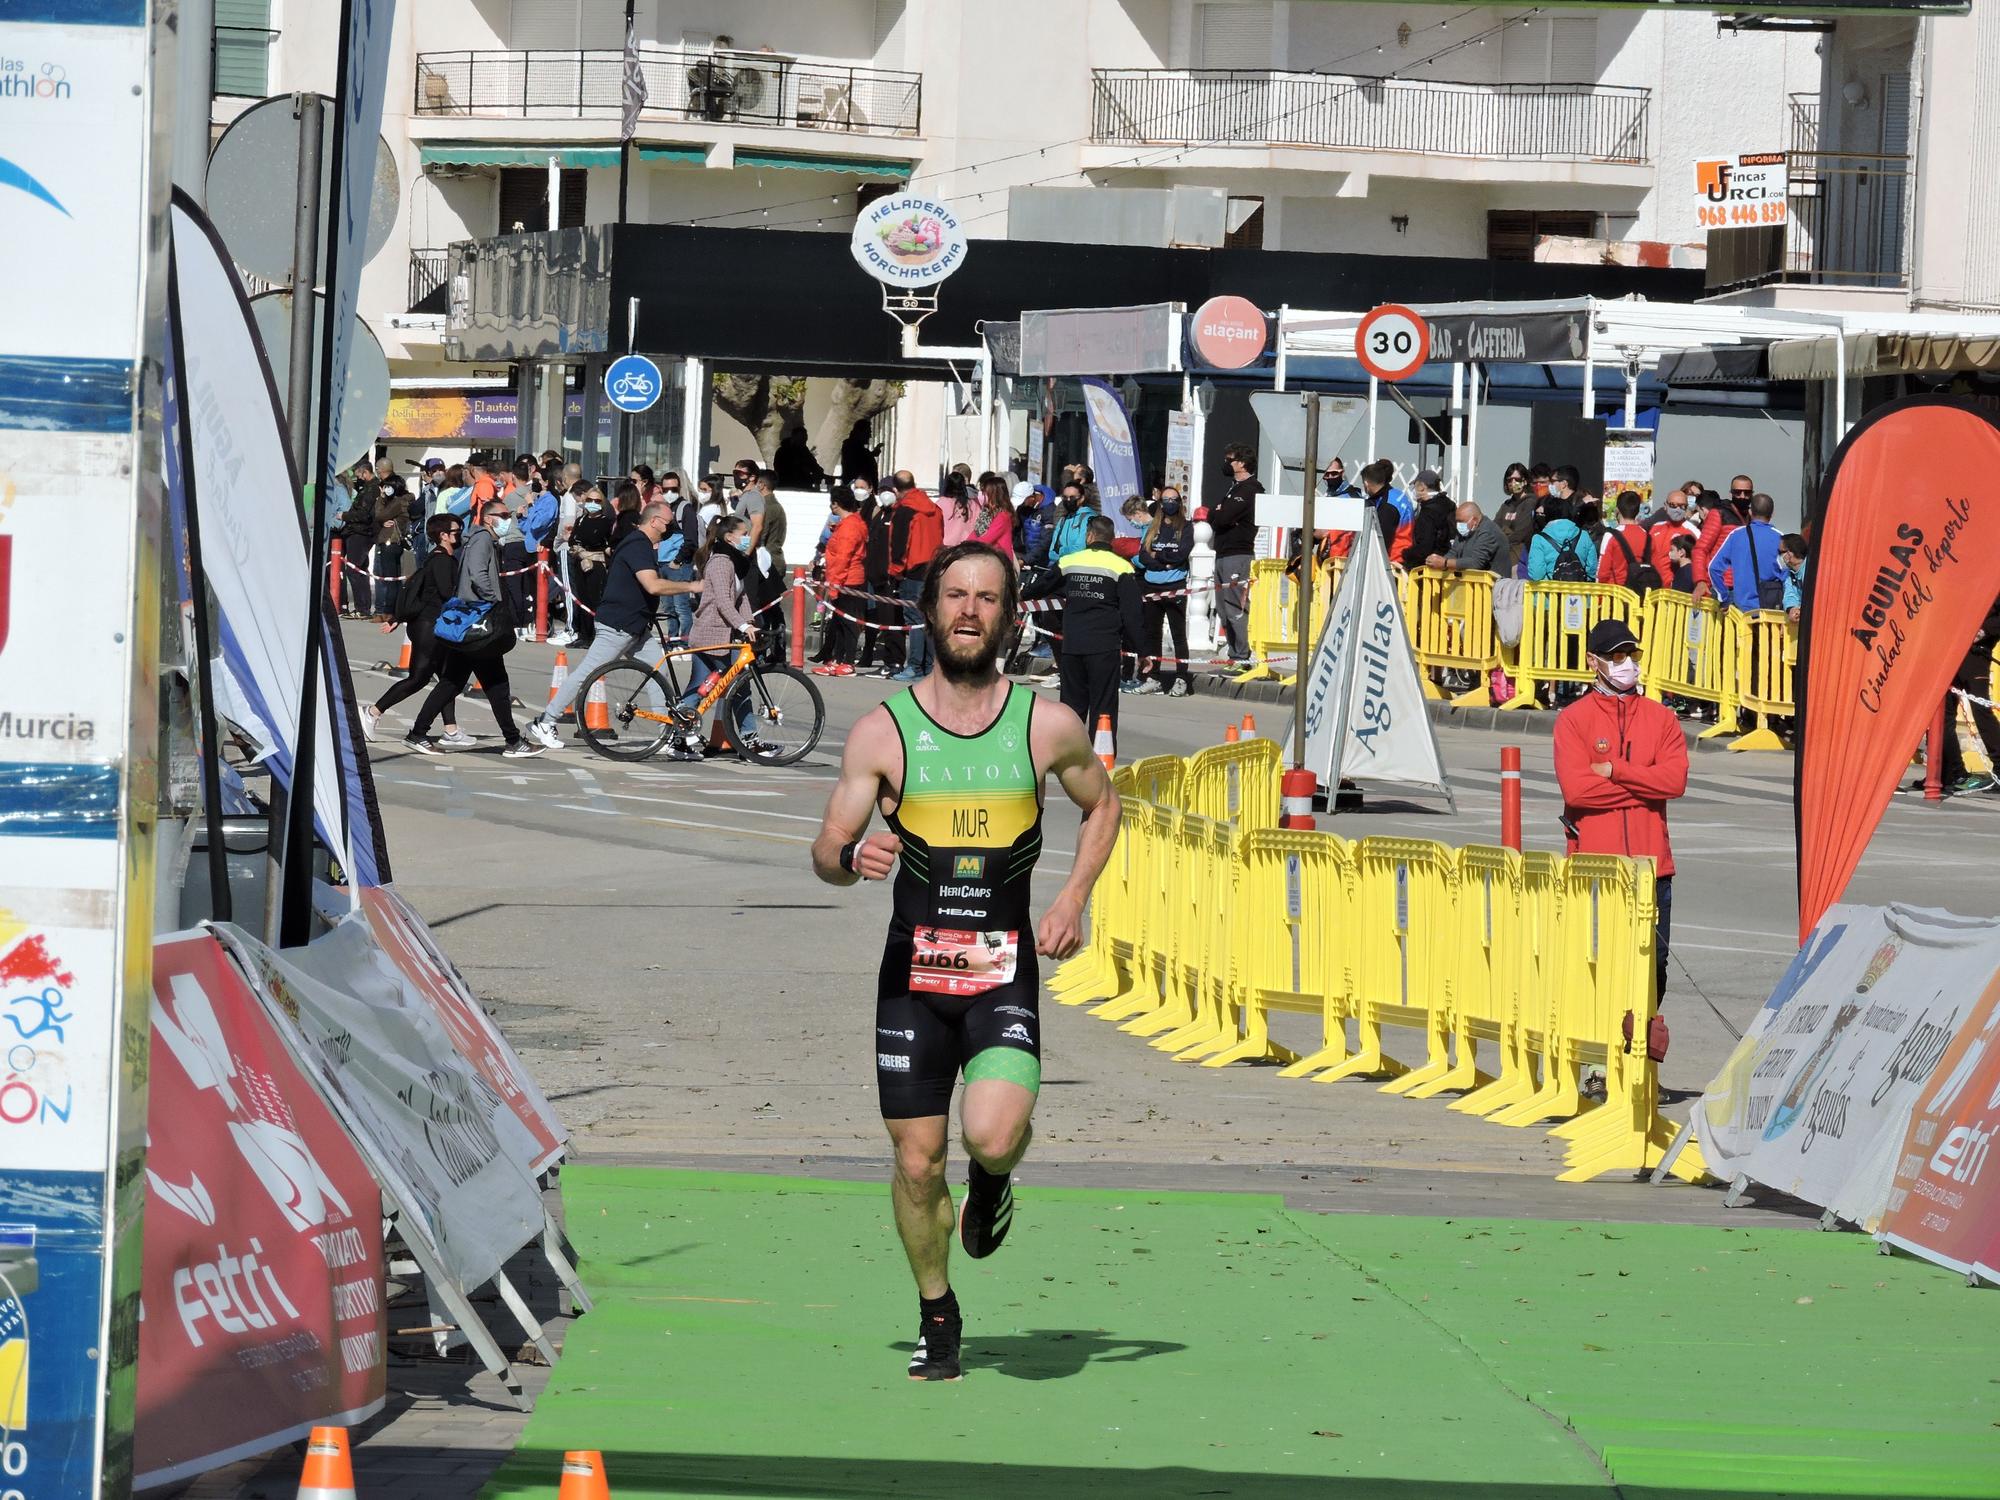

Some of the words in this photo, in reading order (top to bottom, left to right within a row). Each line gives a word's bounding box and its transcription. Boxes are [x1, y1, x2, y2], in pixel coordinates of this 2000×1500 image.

[1740, 155, 1784, 164] INFORMA
[1718, 165, 1767, 185] Fincas
[870, 199, 957, 229] HELADERIA
[1698, 206, 1727, 226] 968
[1731, 204, 1758, 224] 446
[1761, 201, 1786, 222] 839
[1203, 324, 1260, 343] alaçant
[1372, 331, 1412, 354] 30
[1467, 321, 1526, 359] CAFETERIA
[474, 400, 485, 412] El
[568, 401, 581, 413] de
[1071, 575, 1104, 584] AUXILIAR
[1850, 522, 1924, 652] ÁGUILAS
[1067, 591, 1105, 600] SERVICIOS
[1859, 619, 1906, 714] Ciudad
[1901, 572, 1935, 620] del
[1923, 497, 1971, 575] deporte
[1305, 606, 1351, 740] guilas
[1351, 600, 1396, 758] Águilas
[919, 763, 1021, 784] KATOA
[951, 808, 990, 838] MUR
[938, 907, 988, 918] HEAD
